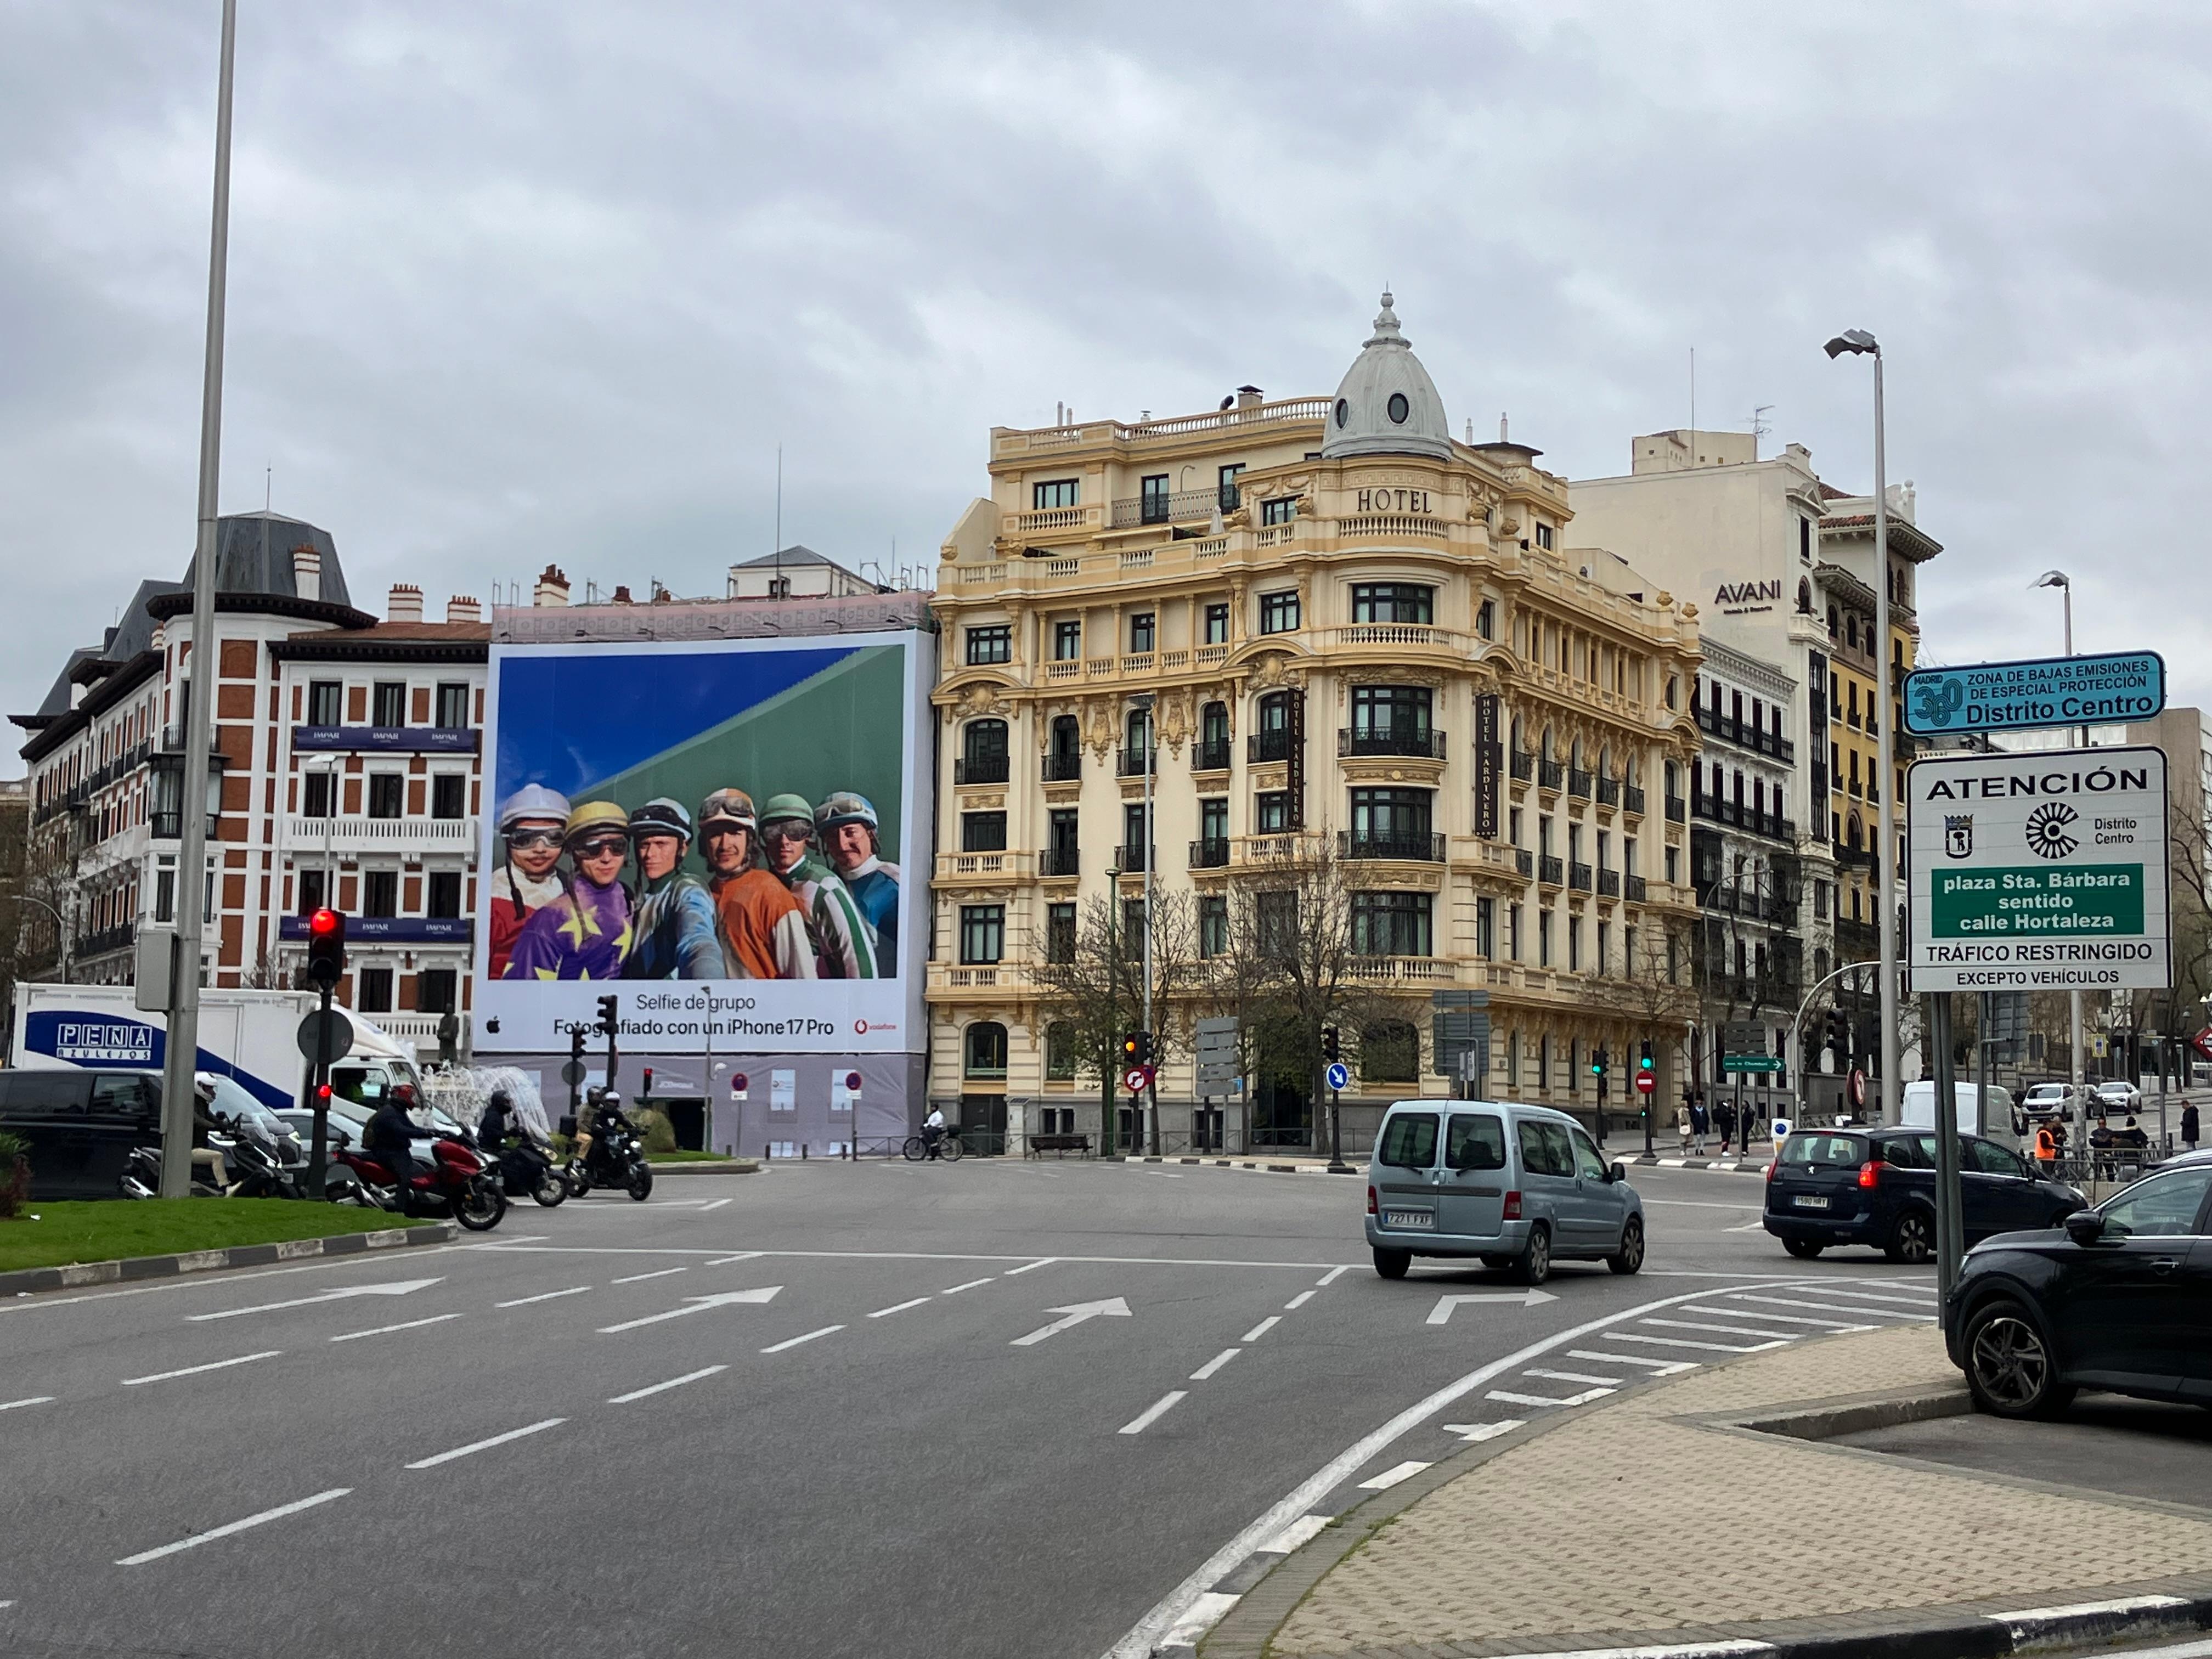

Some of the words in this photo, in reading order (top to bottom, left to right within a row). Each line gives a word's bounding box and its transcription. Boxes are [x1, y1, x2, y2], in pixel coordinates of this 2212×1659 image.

[1357, 489, 1432, 513] HOTEL
[1714, 579, 1780, 604] AVANI
[1914, 675, 1944, 684] MADRID
[1968, 672, 2004, 685] ZONA
[2007, 670, 2025, 682] DE
[2029, 667, 2072, 680] BAJAS
[2076, 661, 2149, 676] EMISIONES
[1971, 689, 1988, 699] DE
[1991, 683, 2056, 698] ESPECIAL
[2059, 674, 2147, 693] PROTECCIÓN
[1967, 701, 2054, 724] Distrito
[2062, 695, 2153, 717] Centro
[1482, 749, 1491, 827] SARDINERO
[1926, 766, 2147, 800] ATENCIÓN
[2095, 817, 2137, 830] Distrito
[2095, 833, 2134, 844] Centro
[1944, 876, 1996, 893] plaza
[2002, 874, 2041, 889] Sta.
[2049, 872, 2130, 888] Bárbara
[1999, 894, 2073, 909] sentido
[1960, 915, 2008, 930] calle
[2015, 913, 2114, 929] Hortaleza
[1926, 943, 2010, 962] TRÁFICO
[2017, 943, 2152, 961] RESTRINGIDO
[1957, 972, 2027, 985] EXCEPTO
[2031, 968, 2119, 984] VEHÍCULOS
[637, 994, 681, 1010] Selfie
[685, 994, 705, 1010] de
[709, 997, 755, 1013] grupo
[668, 1023, 698, 1035] con
[703, 1022, 723, 1035] un
[728, 1019, 784, 1035] iPhone
[787, 1019, 804, 1035] 17
[808, 1019, 834, 1035] Pro
[58, 1049, 149, 1059] AZULEJOS
